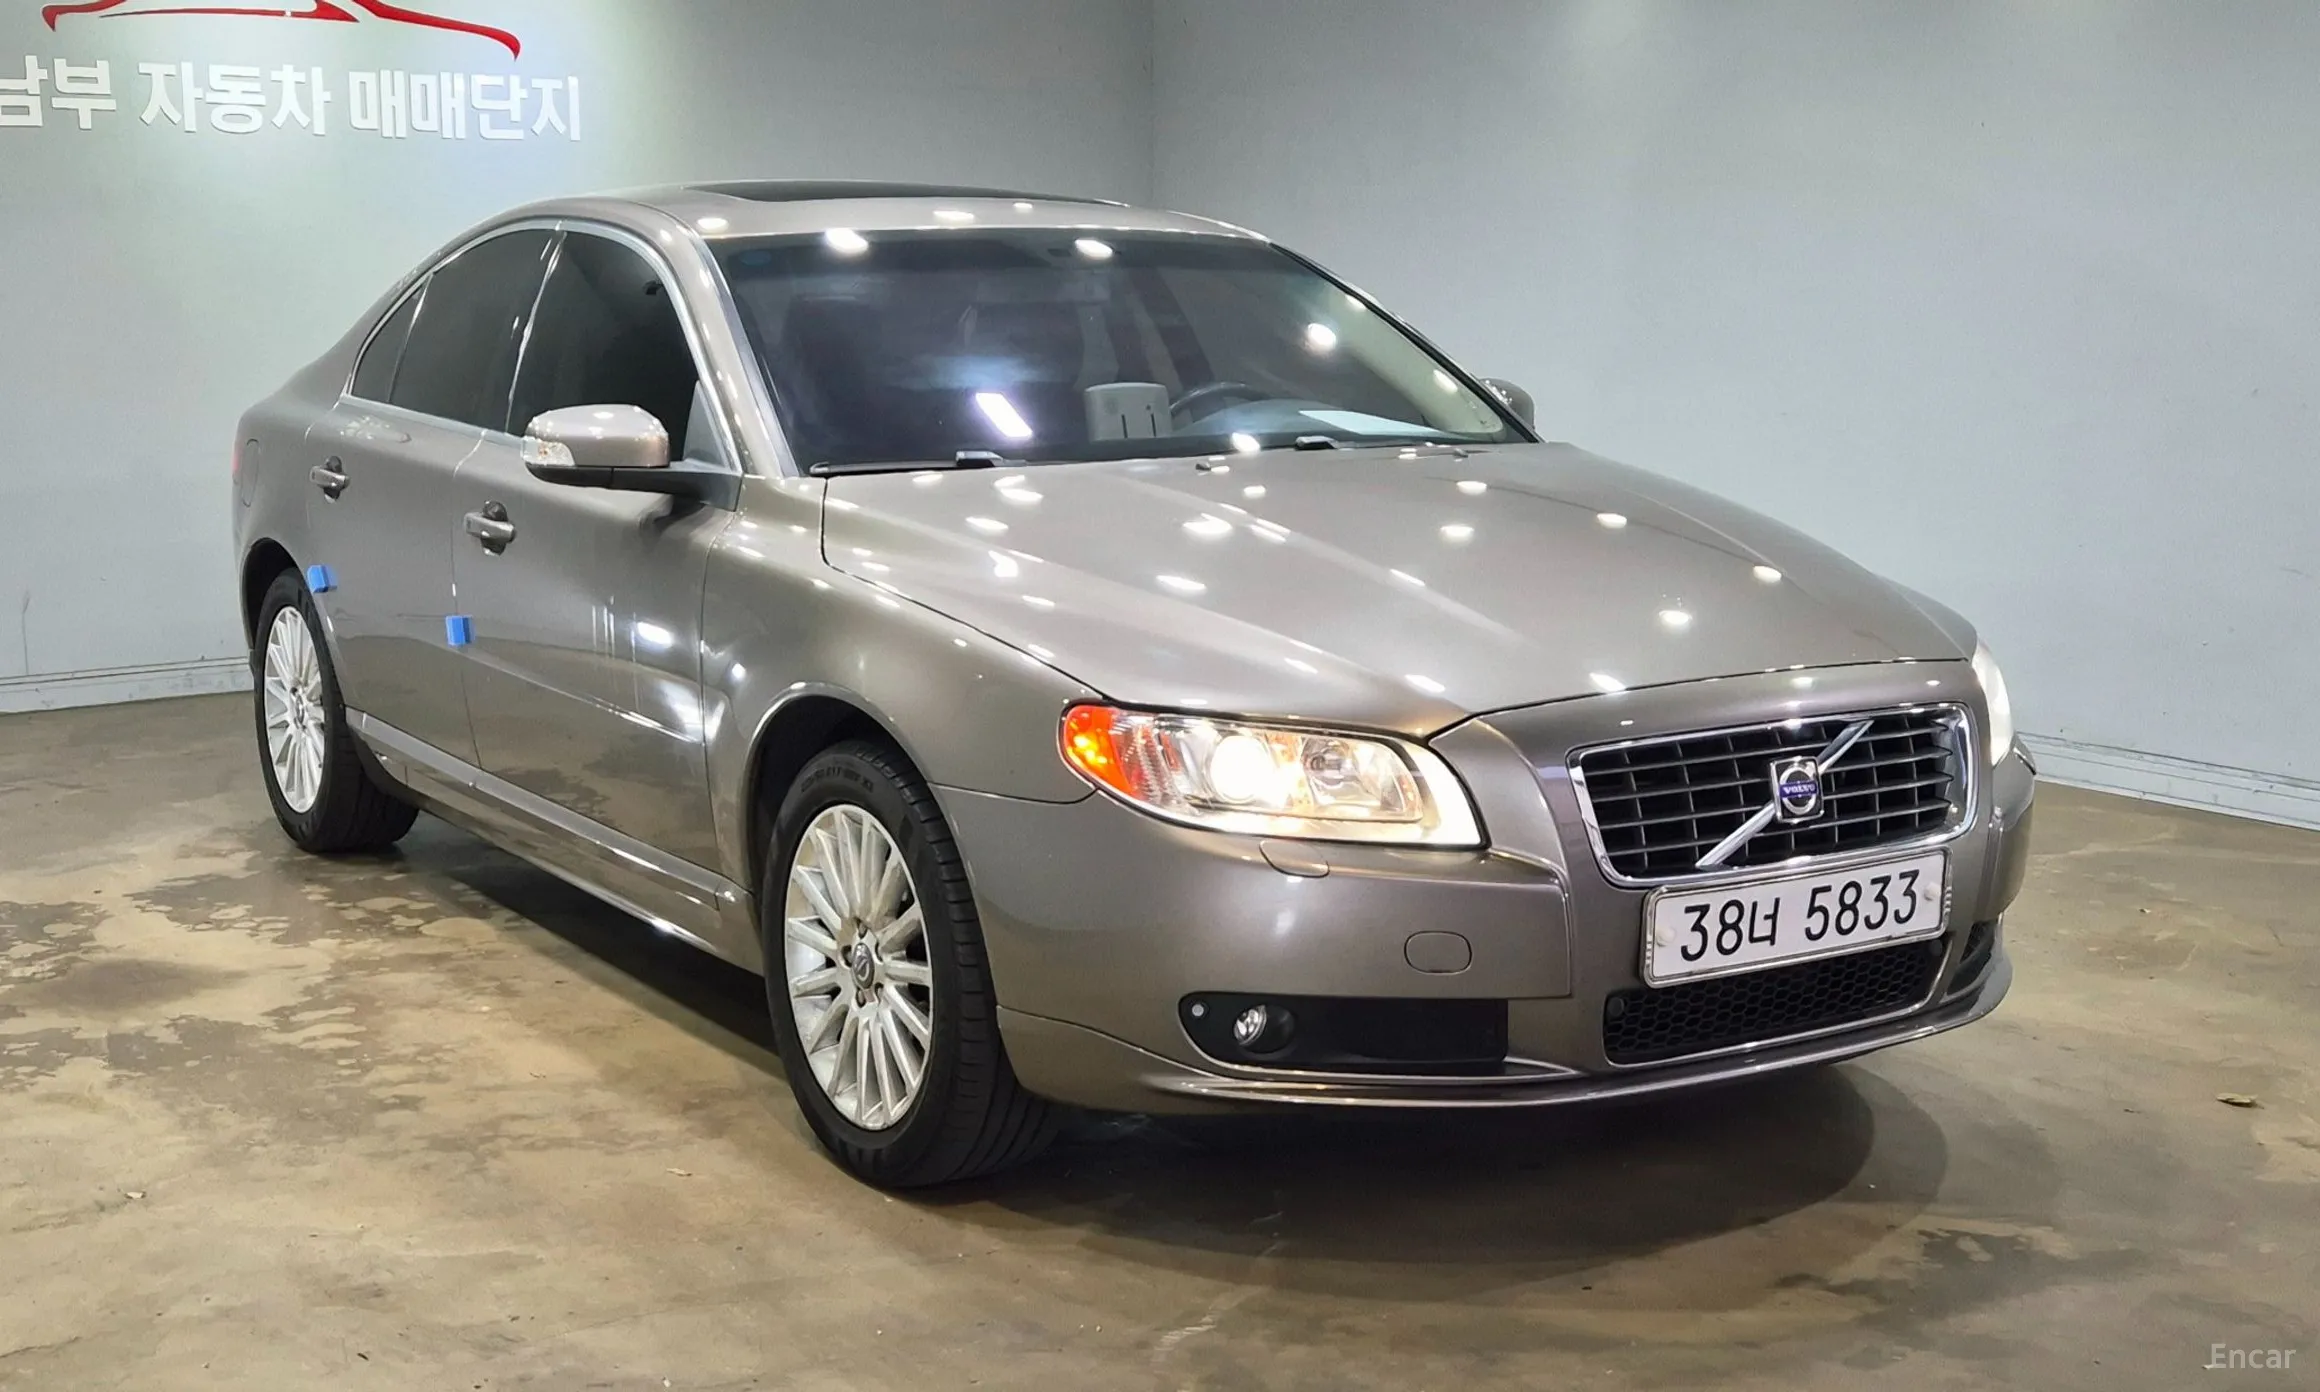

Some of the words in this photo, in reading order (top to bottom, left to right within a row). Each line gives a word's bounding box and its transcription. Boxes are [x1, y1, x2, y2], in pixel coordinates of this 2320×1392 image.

[0, 55, 117, 130] 남부
[138, 61, 331, 136] 자동차
[348, 70, 581, 141] 매매단지
[1782, 784, 1816, 794] VOLVO
[1680, 897, 1781, 962] 38너
[1804, 869, 1920, 941] 5833
